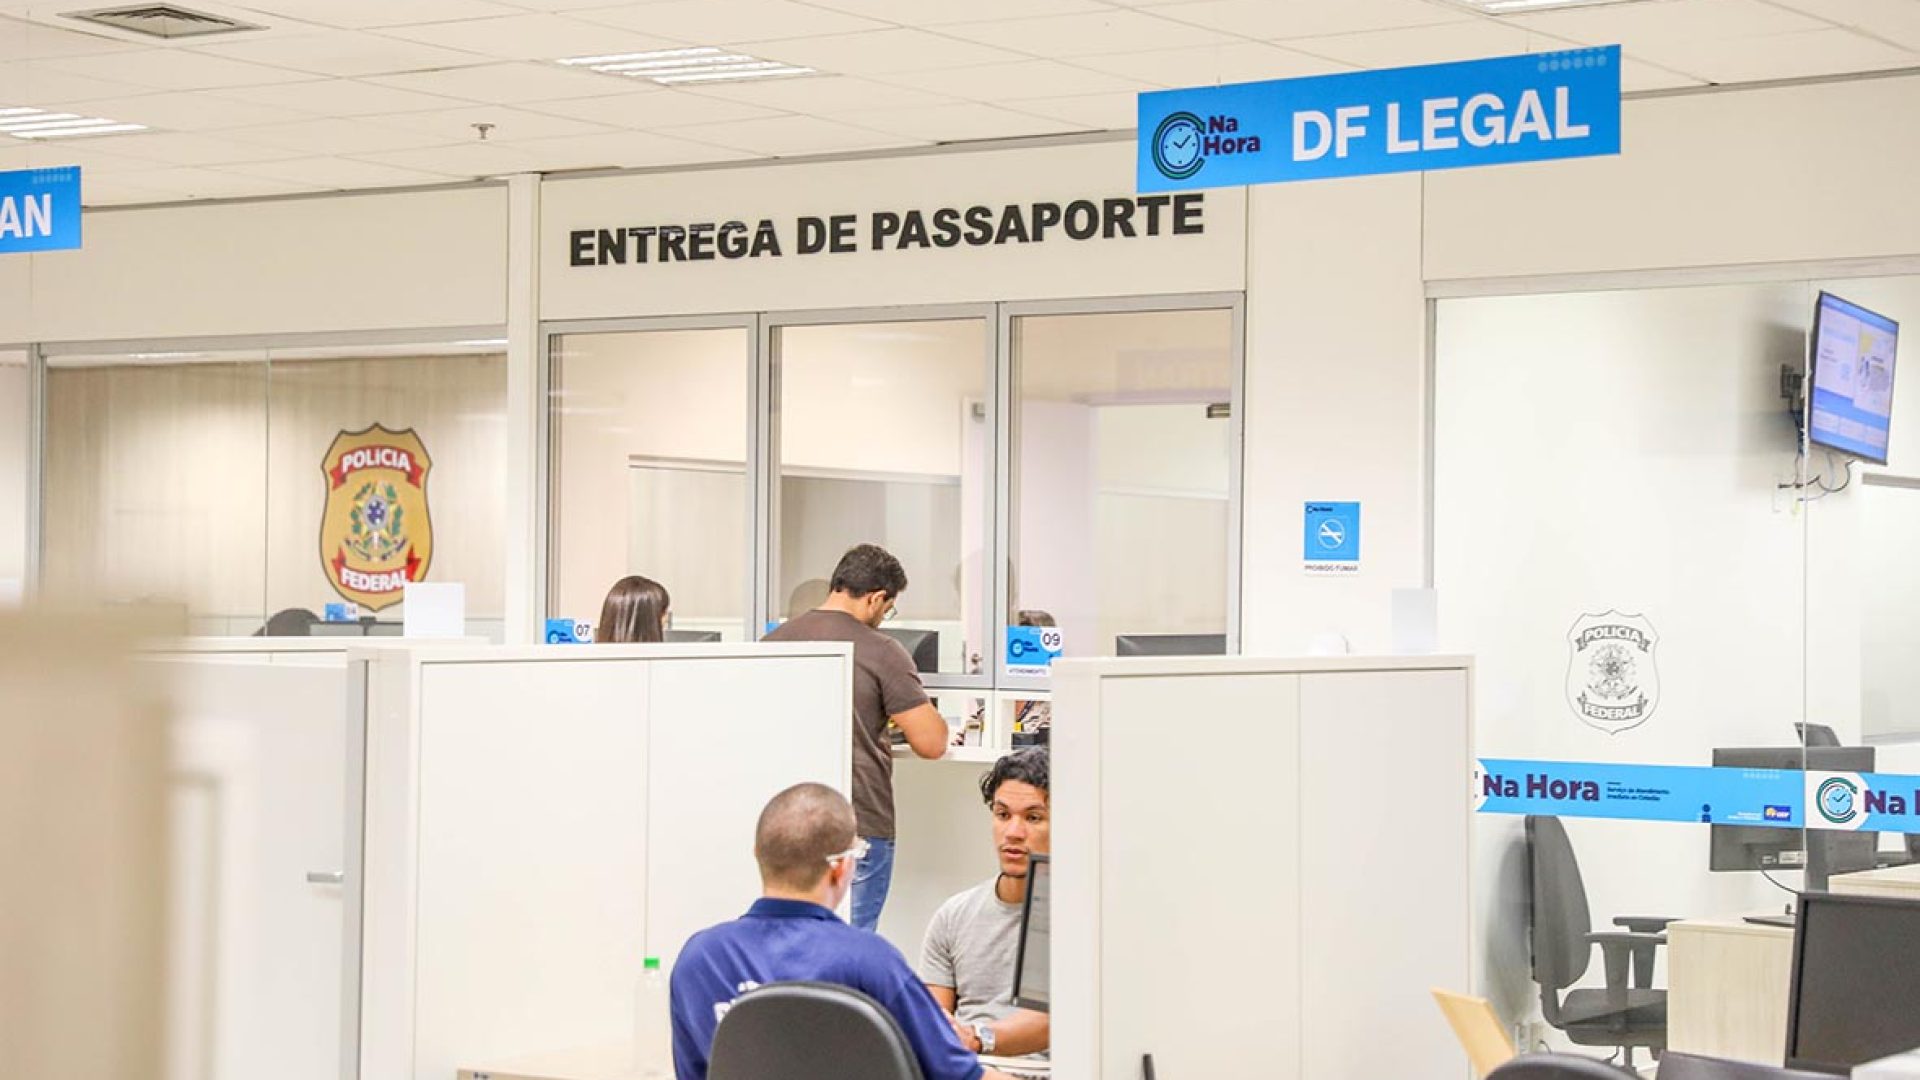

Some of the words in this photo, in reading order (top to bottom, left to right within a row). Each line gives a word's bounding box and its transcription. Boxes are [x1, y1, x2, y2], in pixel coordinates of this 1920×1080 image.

[1208, 115, 1238, 134] Na
[1292, 105, 1370, 162] DF
[1387, 86, 1590, 154] LEGAL
[1203, 135, 1261, 156] Hora
[0, 193, 52, 239] AN
[570, 219, 782, 267] ENTREGA
[797, 214, 857, 255] DE
[872, 193, 1204, 250] PASSAPORTE
[341, 567, 406, 591] FEDERAL
[575, 624, 590, 637] 07
[1042, 632, 1061, 646] 09
[1584, 703, 1641, 719] FEDERAL
[1483, 774, 1519, 798] Na
[1526, 774, 1599, 801] Hora
[1864, 790, 1906, 815] Na
